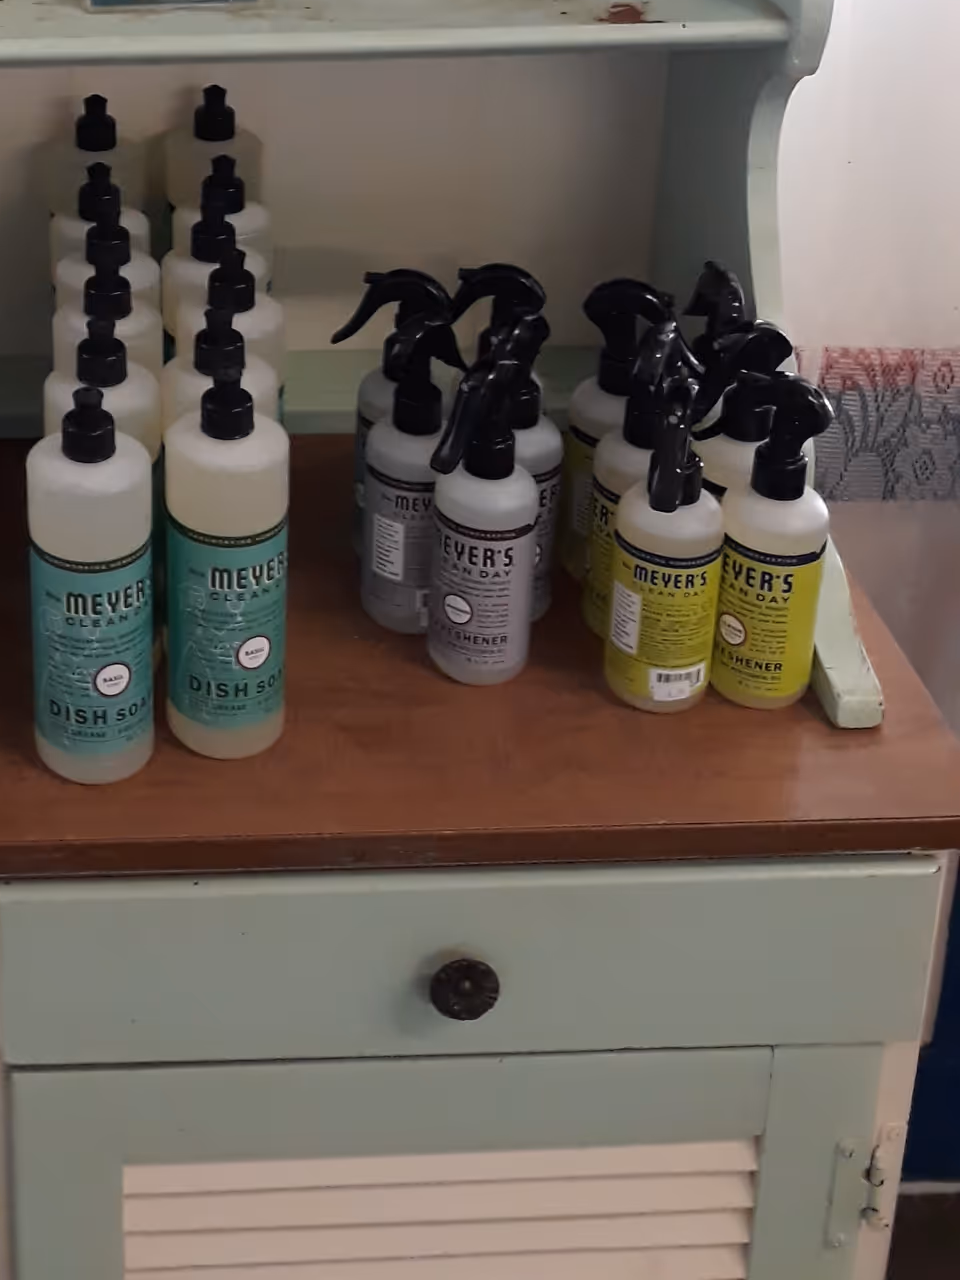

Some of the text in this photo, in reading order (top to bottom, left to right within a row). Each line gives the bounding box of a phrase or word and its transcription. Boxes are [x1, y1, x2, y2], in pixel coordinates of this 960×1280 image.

[443, 535, 514, 568] EYER'S
[479, 570, 512, 579] DAY
[634, 564, 708, 589] MEYER'S
[722, 554, 795, 594] EYER'S
[756, 593, 790, 604] DAY
[190, 675, 249, 699] DISH
[49, 699, 108, 725] DISH
